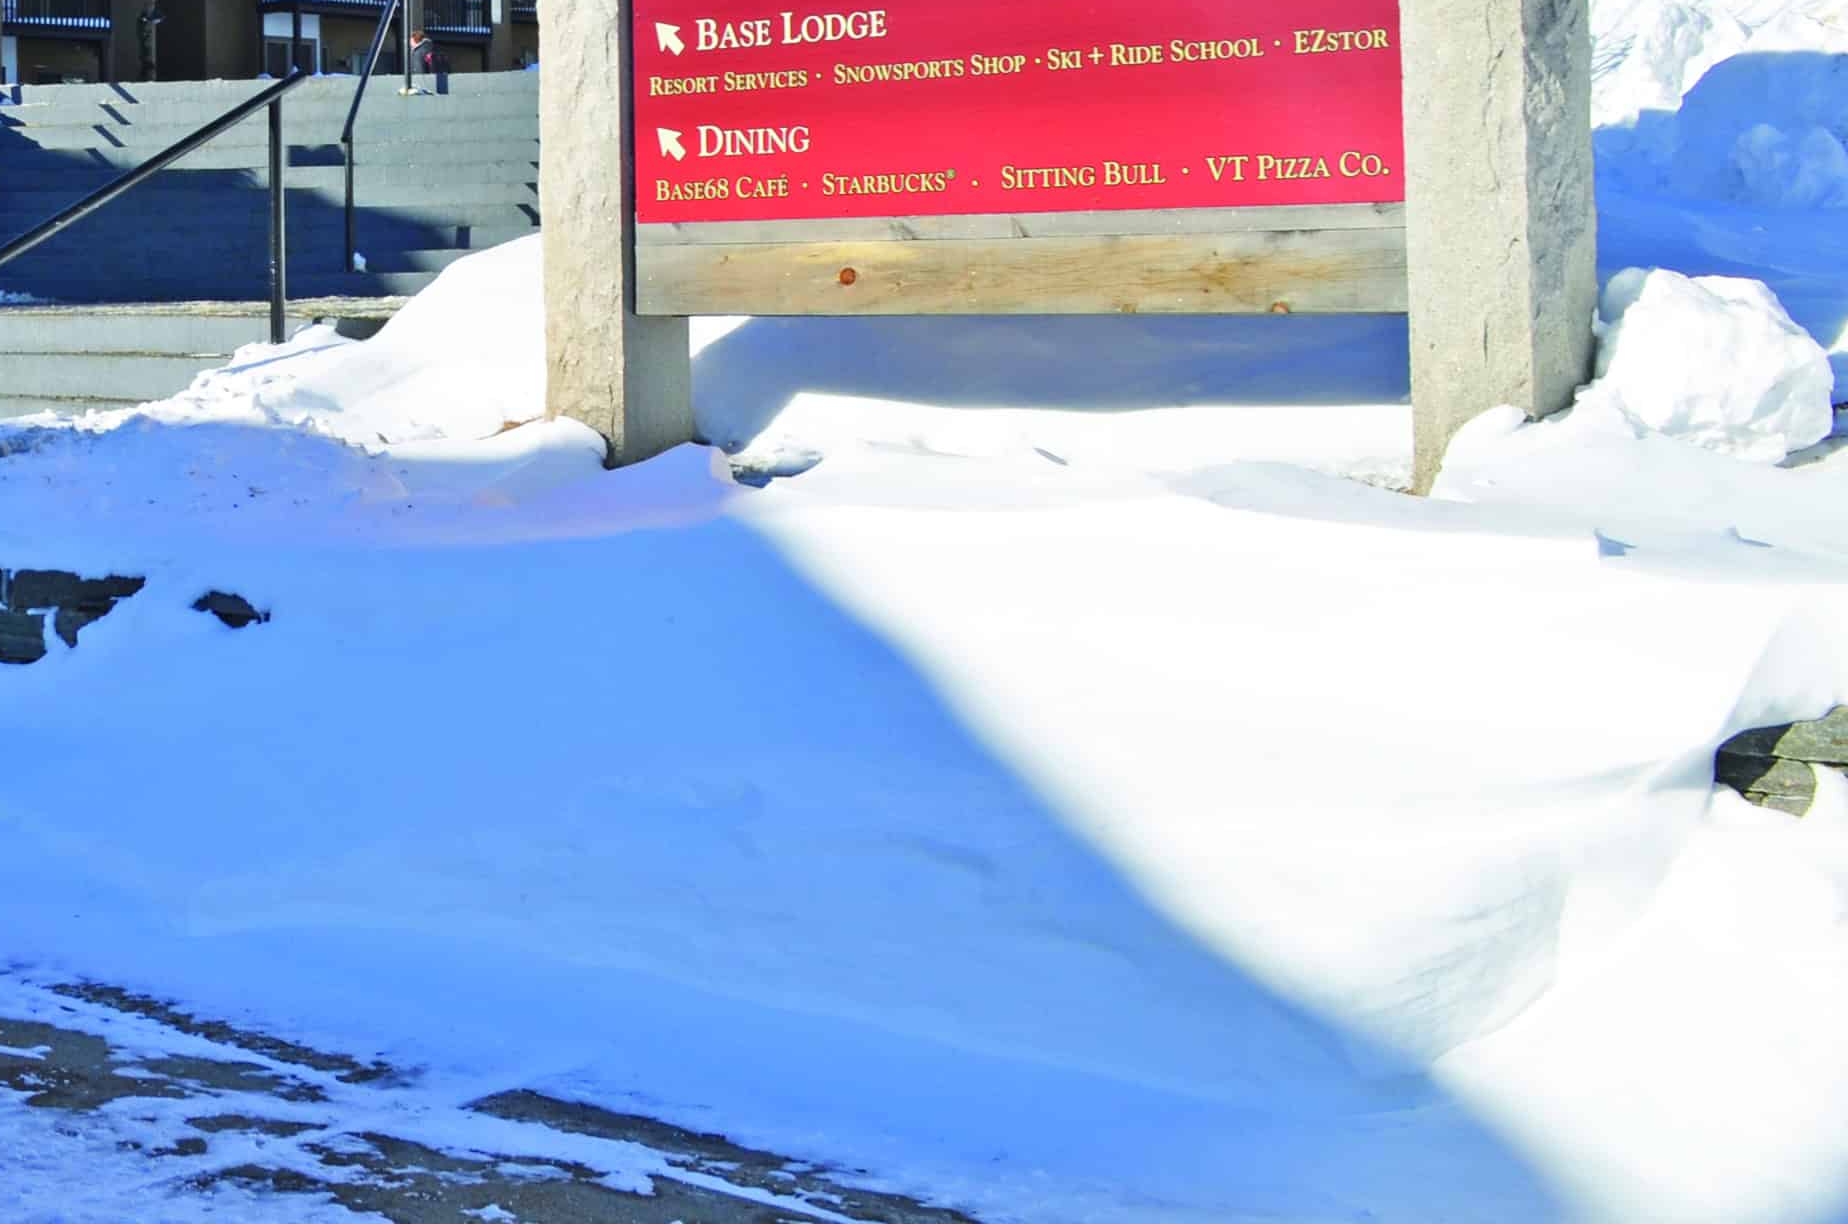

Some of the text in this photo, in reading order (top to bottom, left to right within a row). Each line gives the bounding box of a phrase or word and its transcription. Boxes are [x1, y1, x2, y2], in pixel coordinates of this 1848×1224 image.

[695, 9, 888, 51] BASE LODGE
[649, 76, 719, 97] RESORT
[724, 70, 808, 92] SERVICES
[834, 59, 965, 85] SNOWSPORTS
[970, 54, 1026, 76] SHOP
[1047, 48, 1083, 70] SKI
[1109, 43, 1164, 66] RIDE
[1170, 38, 1265, 62] SCHOOL
[696, 125, 810, 157] DINING
[655, 178, 729, 201] BASE68
[1001, 165, 1096, 189] SITTING
[1103, 161, 1166, 185] BULL
[1205, 155, 1249, 181] VT
[1256, 155, 1331, 180] PIZZA
[1338, 151, 1390, 177] CO.
